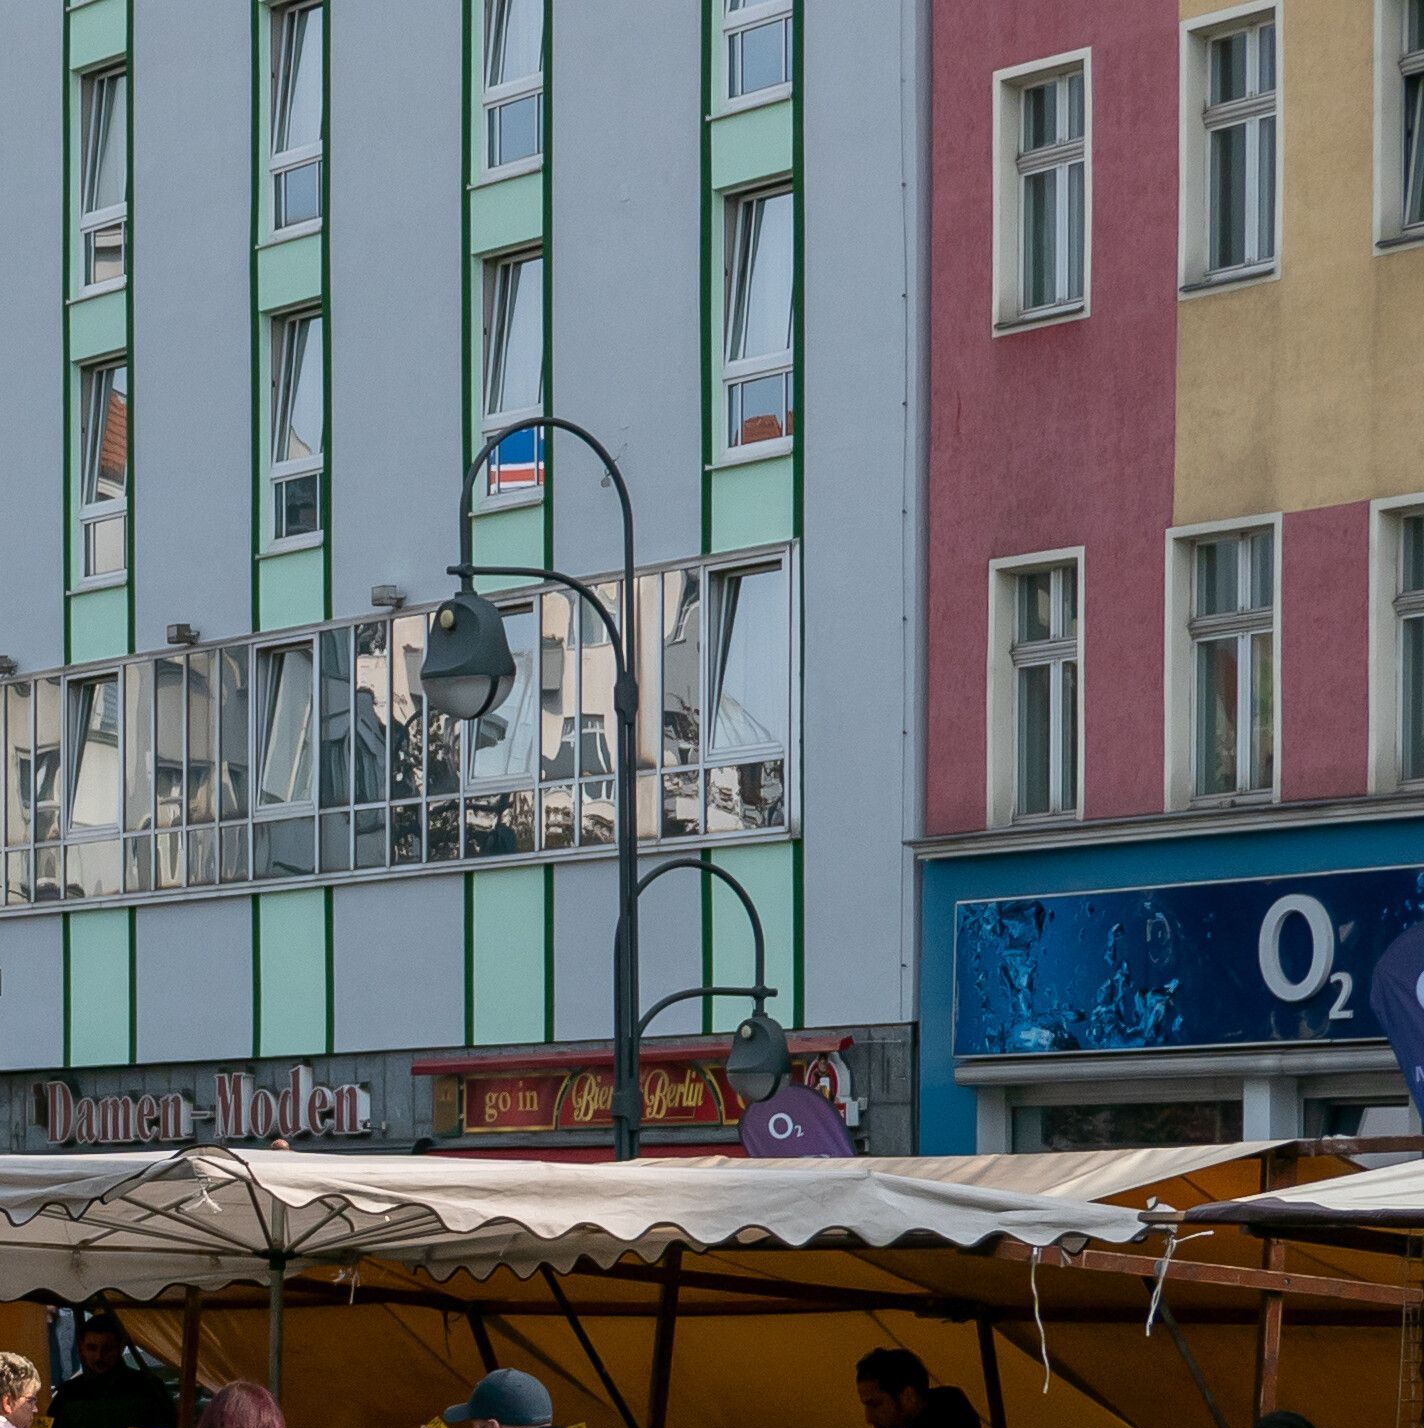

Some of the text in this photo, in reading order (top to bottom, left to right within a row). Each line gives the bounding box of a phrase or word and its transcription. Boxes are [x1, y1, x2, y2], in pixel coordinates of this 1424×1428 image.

[42, 1064, 369, 1145] Damen-Moden
[484, 1088, 512, 1123] go
[516, 1080, 539, 1112] in
